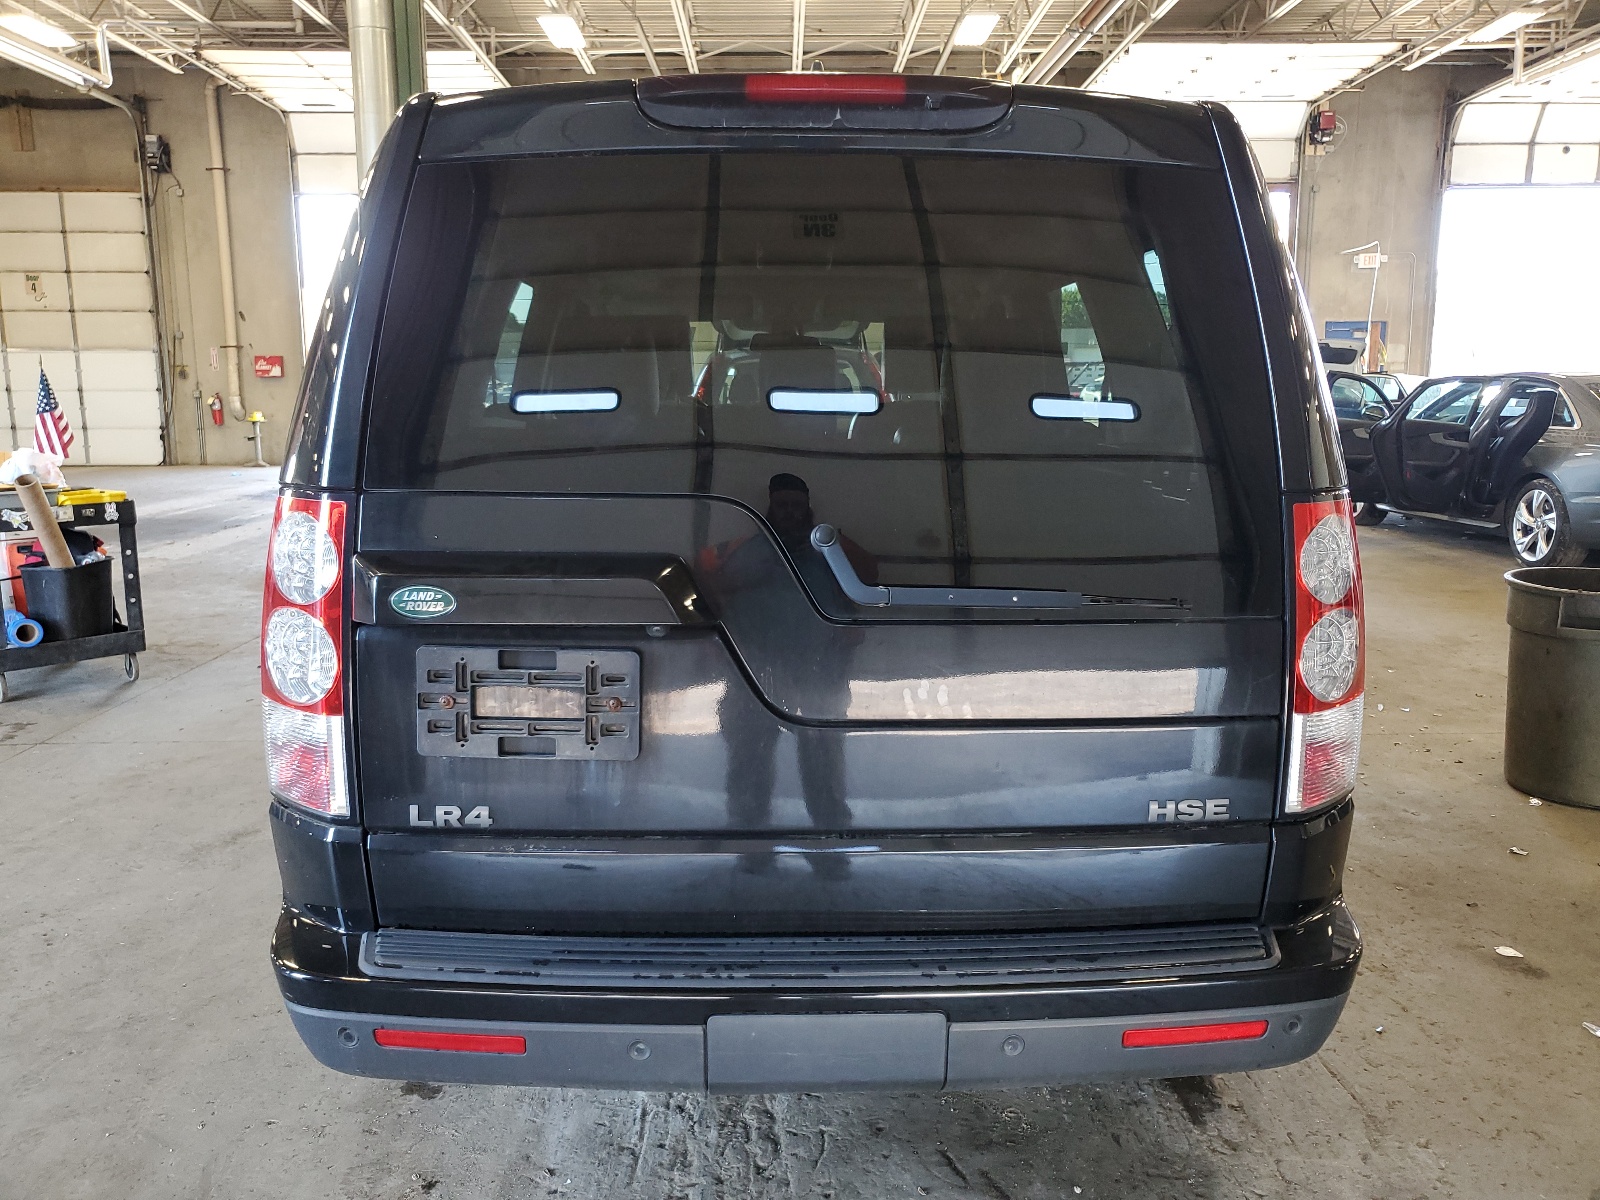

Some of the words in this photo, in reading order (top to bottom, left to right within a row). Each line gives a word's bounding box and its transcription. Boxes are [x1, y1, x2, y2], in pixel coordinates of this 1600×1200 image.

[1364, 255, 1377, 266] EXIT
[31, 282, 37, 293] 4
[402, 591, 435, 601] LAND
[405, 601, 445, 611] ROVER
[409, 804, 493, 827] LR4
[1148, 798, 1230, 822] HSE
